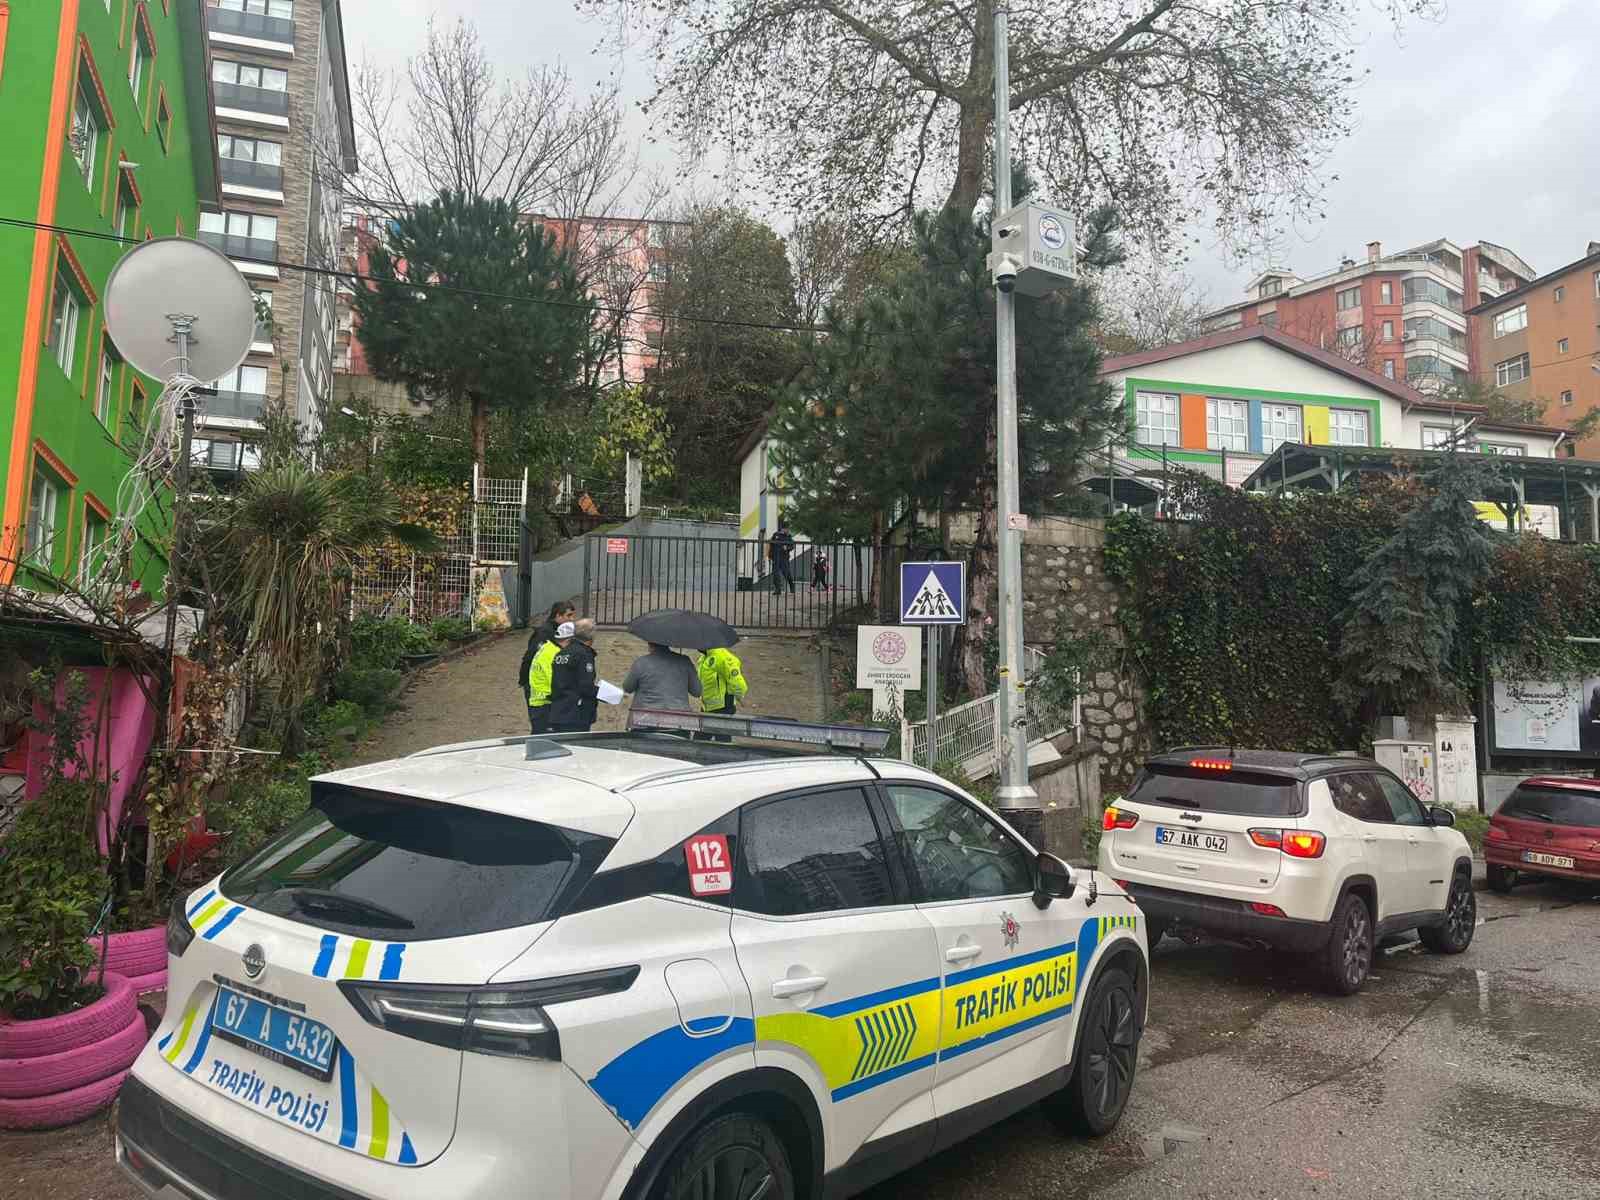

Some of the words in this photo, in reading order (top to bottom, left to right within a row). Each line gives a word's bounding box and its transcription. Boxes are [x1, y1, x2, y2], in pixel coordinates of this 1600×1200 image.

[1163, 830, 1175, 843] 67
[1180, 833, 1200, 847] AAK
[1205, 836, 1226, 850] 042
[1180, 812, 1202, 823] Jeep
[691, 841, 725, 869] 112
[955, 975, 1018, 1030] TRAFİK
[1022, 957, 1072, 1007] POLİSİ
[225, 994, 249, 1030] 67
[260, 1007, 272, 1042] A
[285, 1016, 332, 1065] 5432
[208, 1060, 266, 1105] TRAFİK
[265, 1085, 329, 1132] POLİSİ
